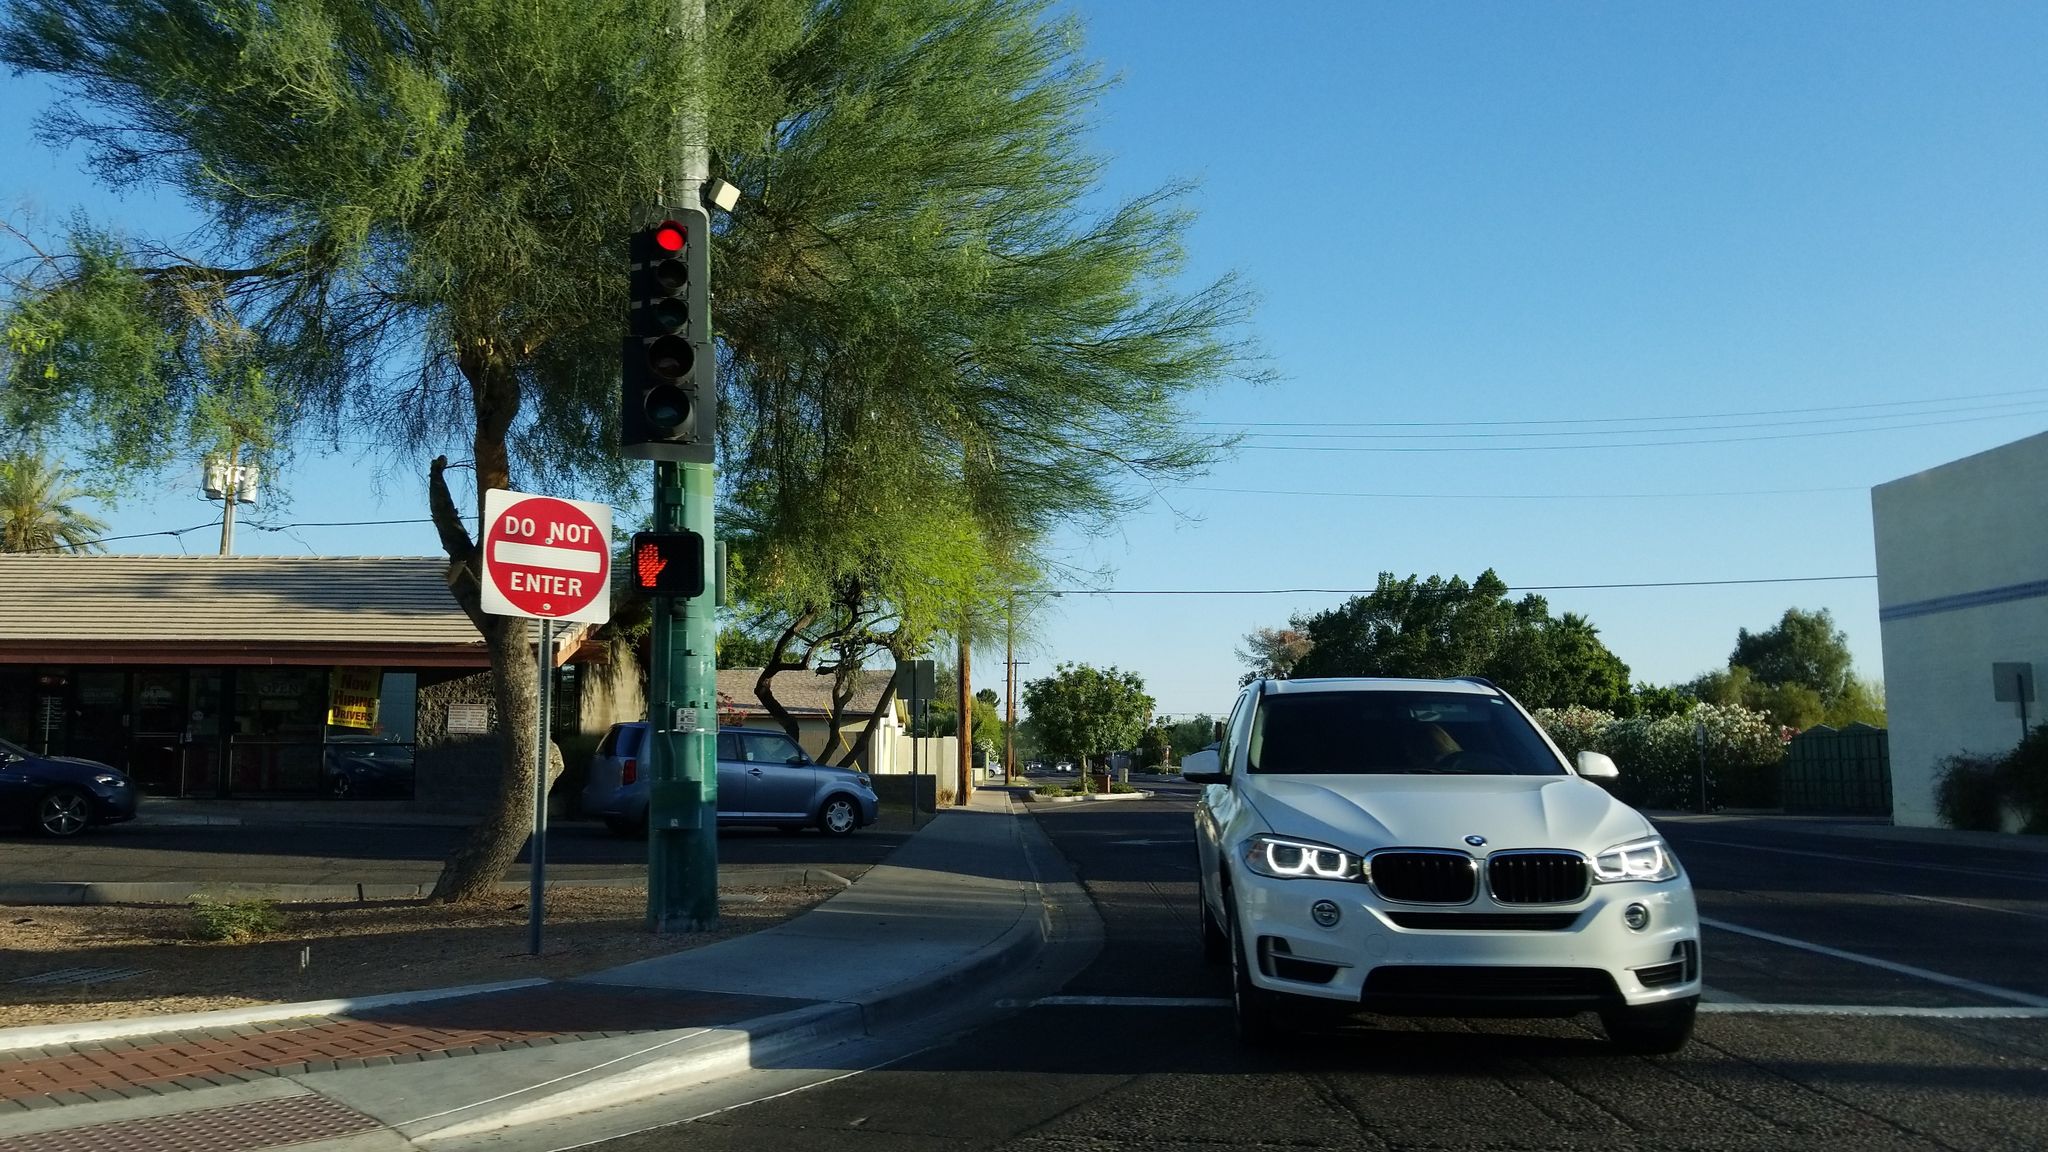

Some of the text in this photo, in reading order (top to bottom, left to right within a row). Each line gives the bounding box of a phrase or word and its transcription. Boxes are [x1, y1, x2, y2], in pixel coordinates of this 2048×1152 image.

[505, 515, 593, 544] DO NOT
[511, 571, 582, 597] ENTER
